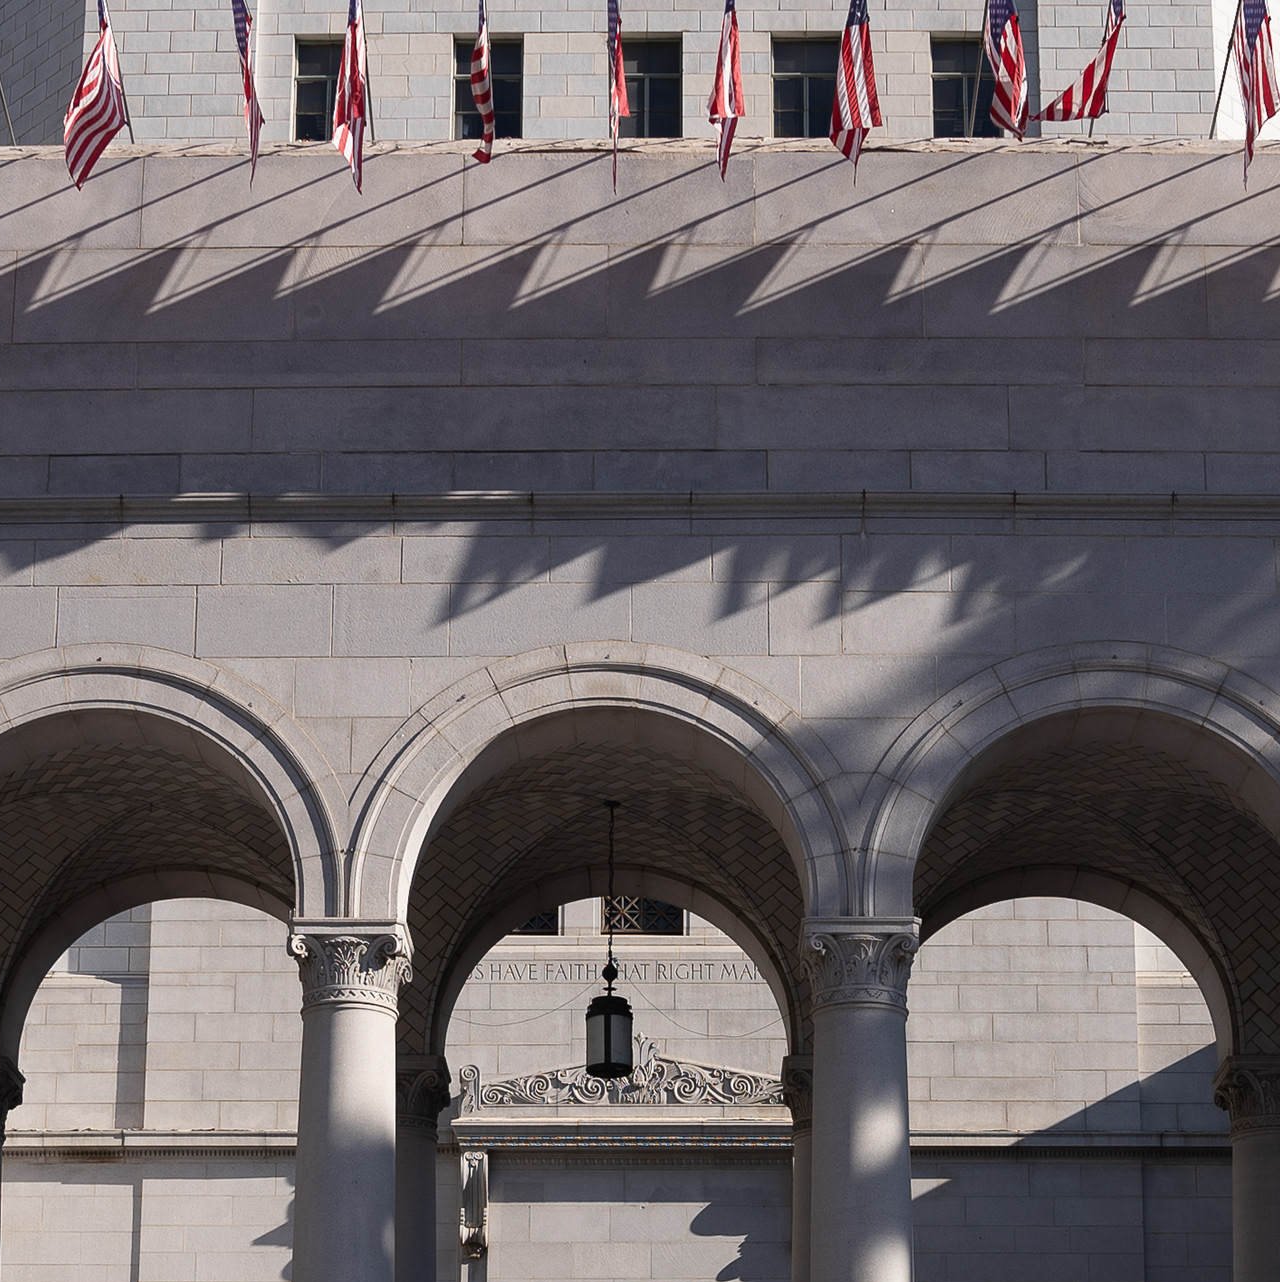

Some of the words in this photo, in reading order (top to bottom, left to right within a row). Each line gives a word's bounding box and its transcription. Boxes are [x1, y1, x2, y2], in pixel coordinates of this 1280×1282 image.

[489, 962, 538, 981] HAVE
[544, 962, 598, 981] FAITH
[657, 962, 715, 981] RIGHT
